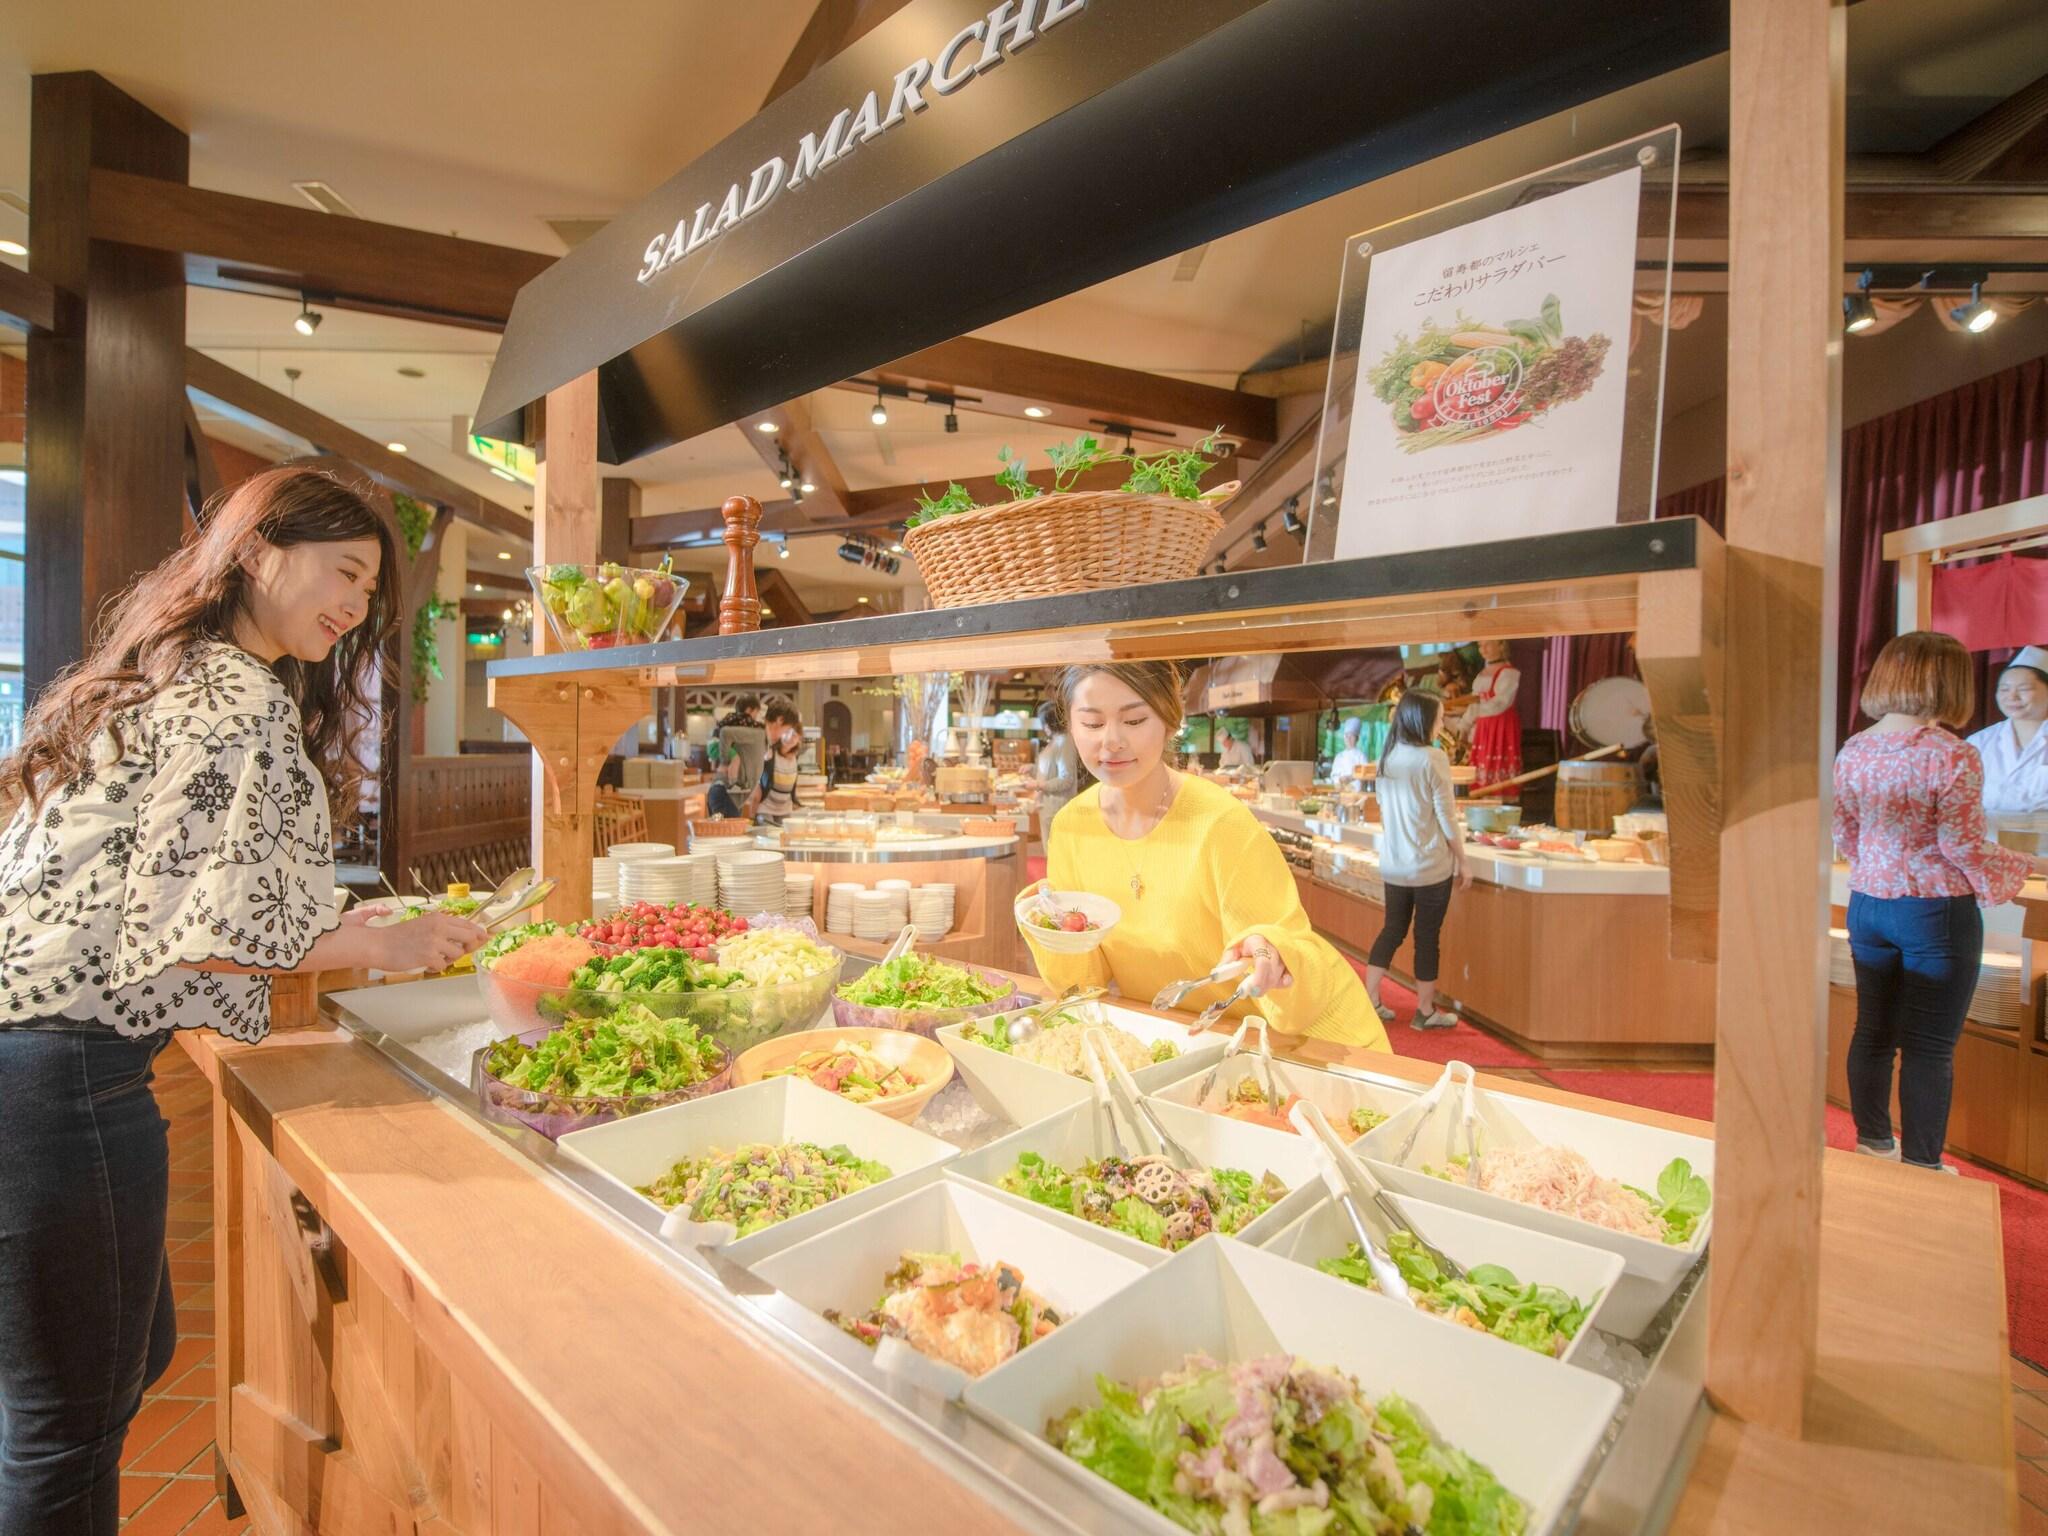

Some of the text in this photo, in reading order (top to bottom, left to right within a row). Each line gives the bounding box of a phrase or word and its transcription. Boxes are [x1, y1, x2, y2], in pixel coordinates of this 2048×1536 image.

[637, 156, 787, 283] SALAD
[1414, 255, 1567, 307] こだわりサラダバー
